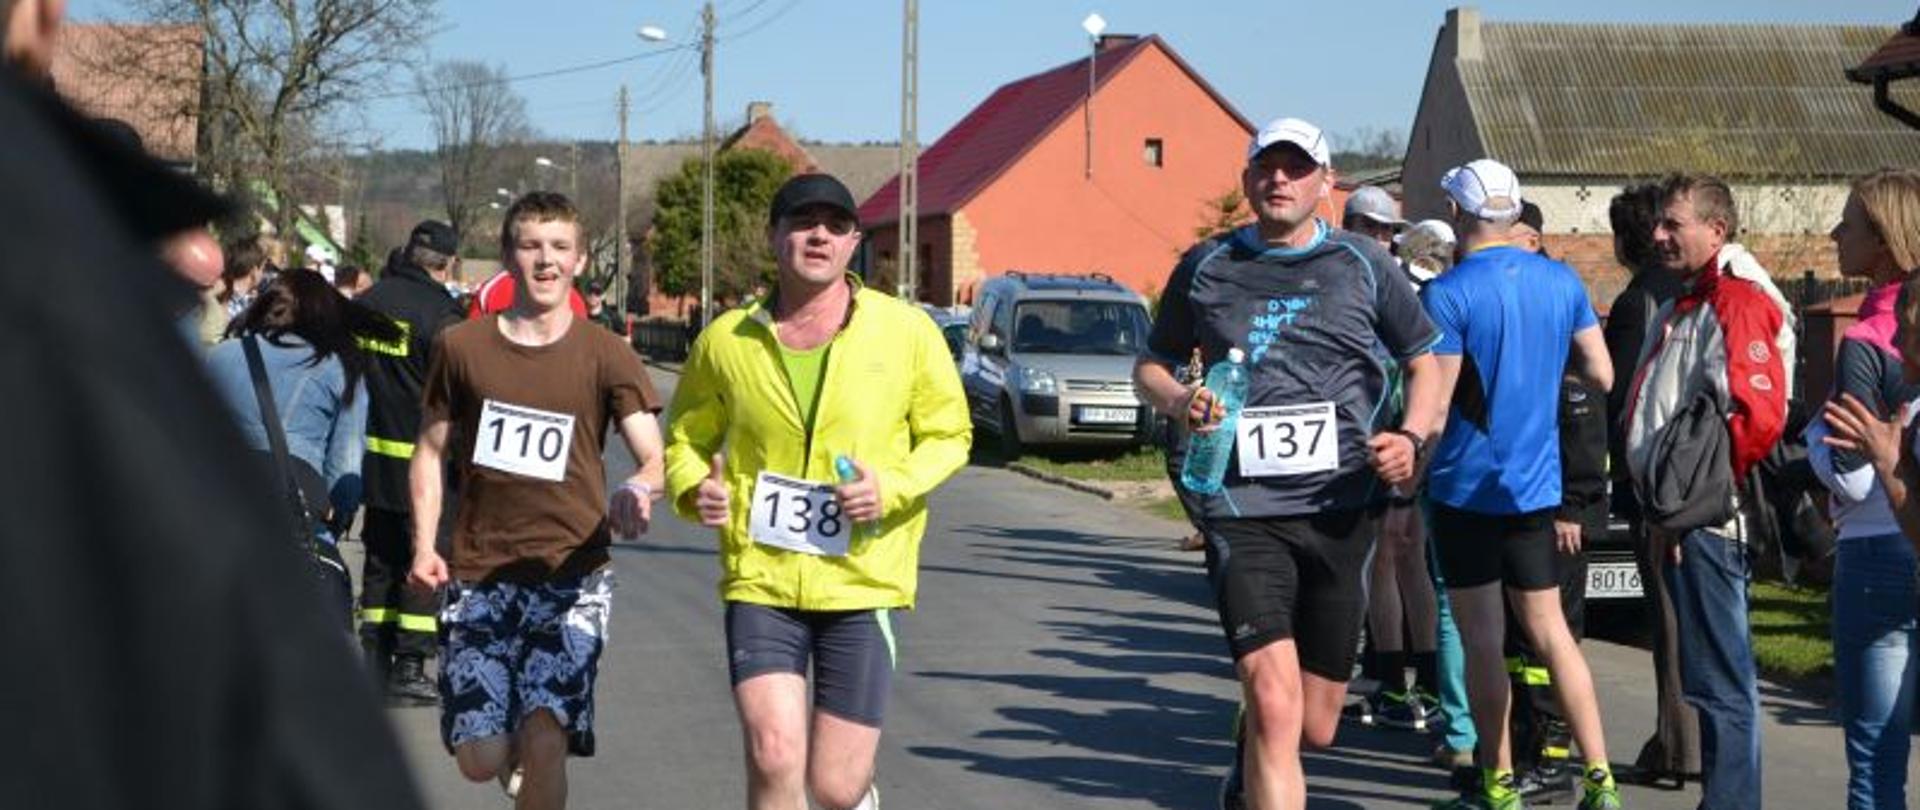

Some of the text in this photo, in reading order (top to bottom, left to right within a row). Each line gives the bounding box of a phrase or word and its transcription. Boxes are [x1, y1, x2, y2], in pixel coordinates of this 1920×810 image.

[489, 417, 564, 462] 110
[1248, 419, 1327, 460] 137
[764, 490, 842, 537] 138
[1591, 569, 1640, 590] 8016
